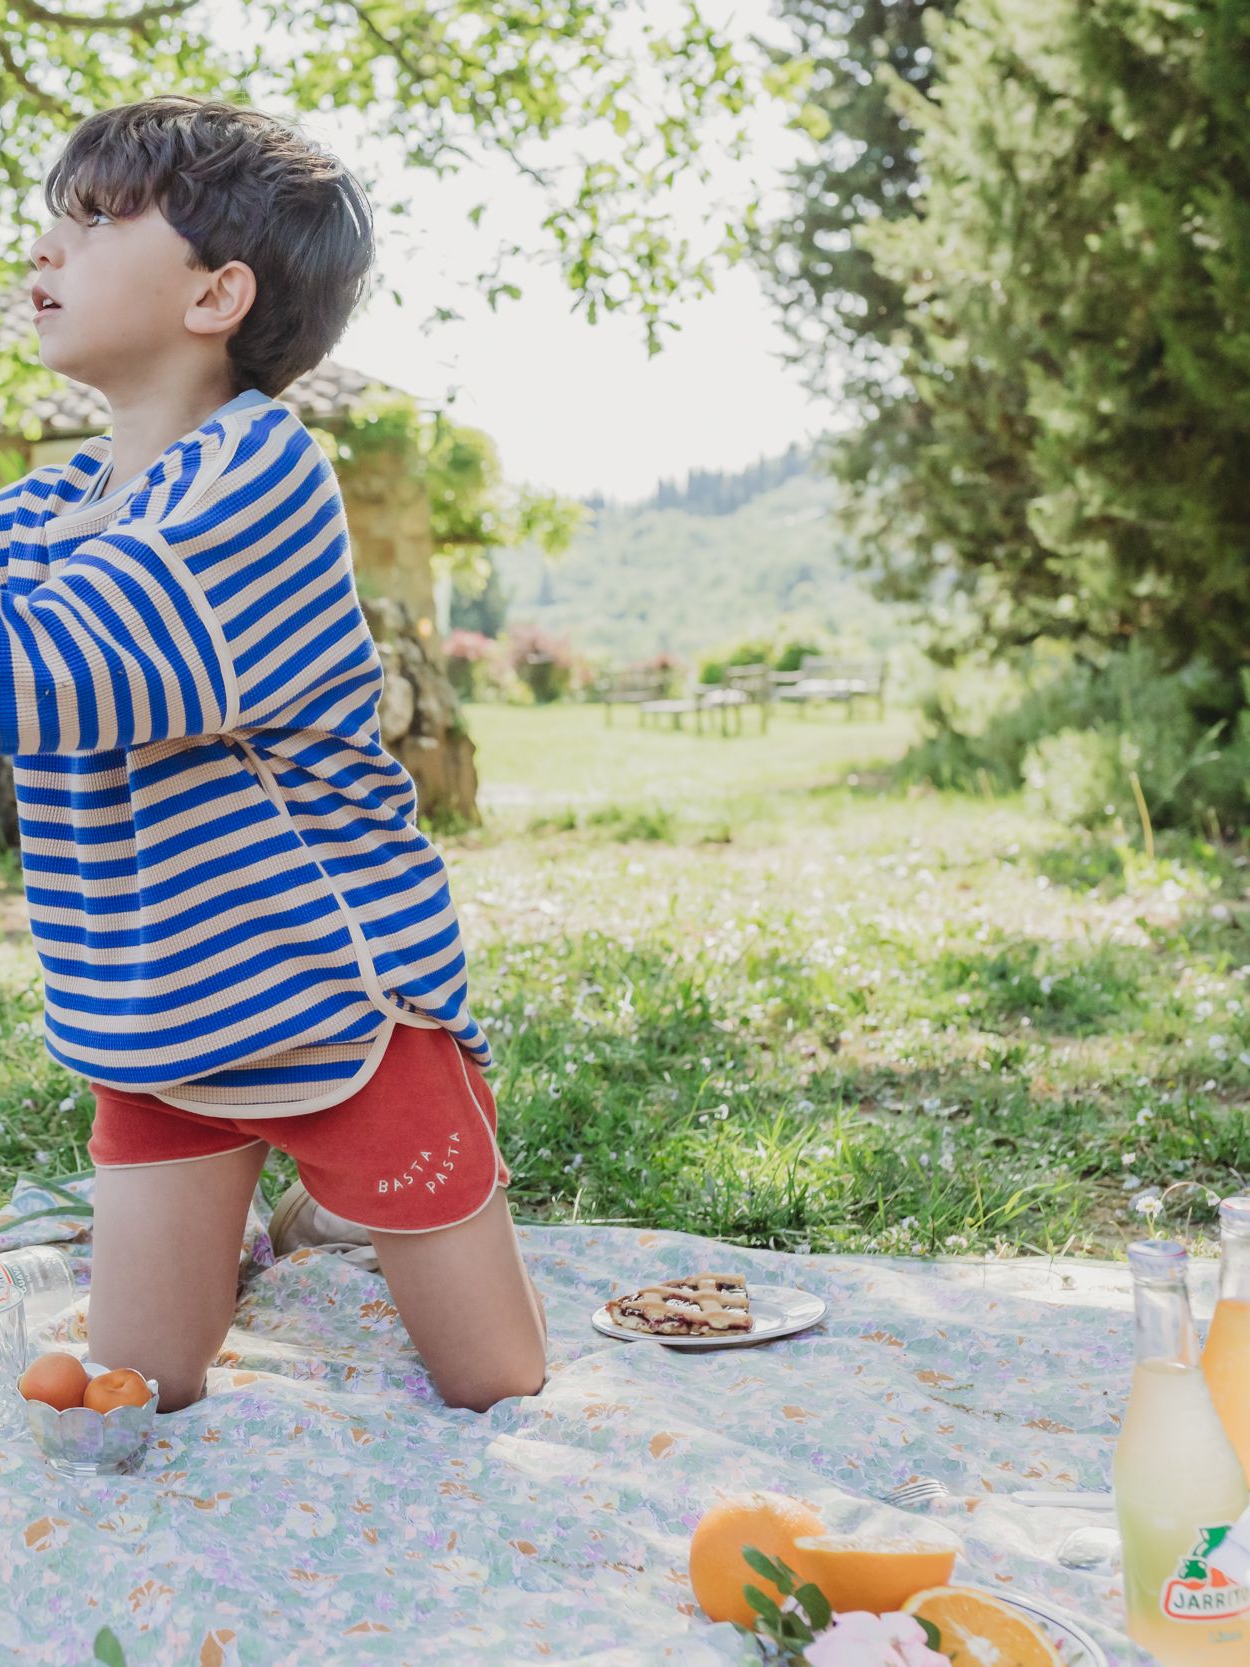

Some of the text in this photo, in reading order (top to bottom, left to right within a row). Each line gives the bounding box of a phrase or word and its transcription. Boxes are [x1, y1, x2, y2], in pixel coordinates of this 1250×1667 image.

[378, 1151, 432, 1193] BASTA
[425, 1132, 460, 1194] PASTA
[1173, 1586, 1249, 1610] JARRITO
